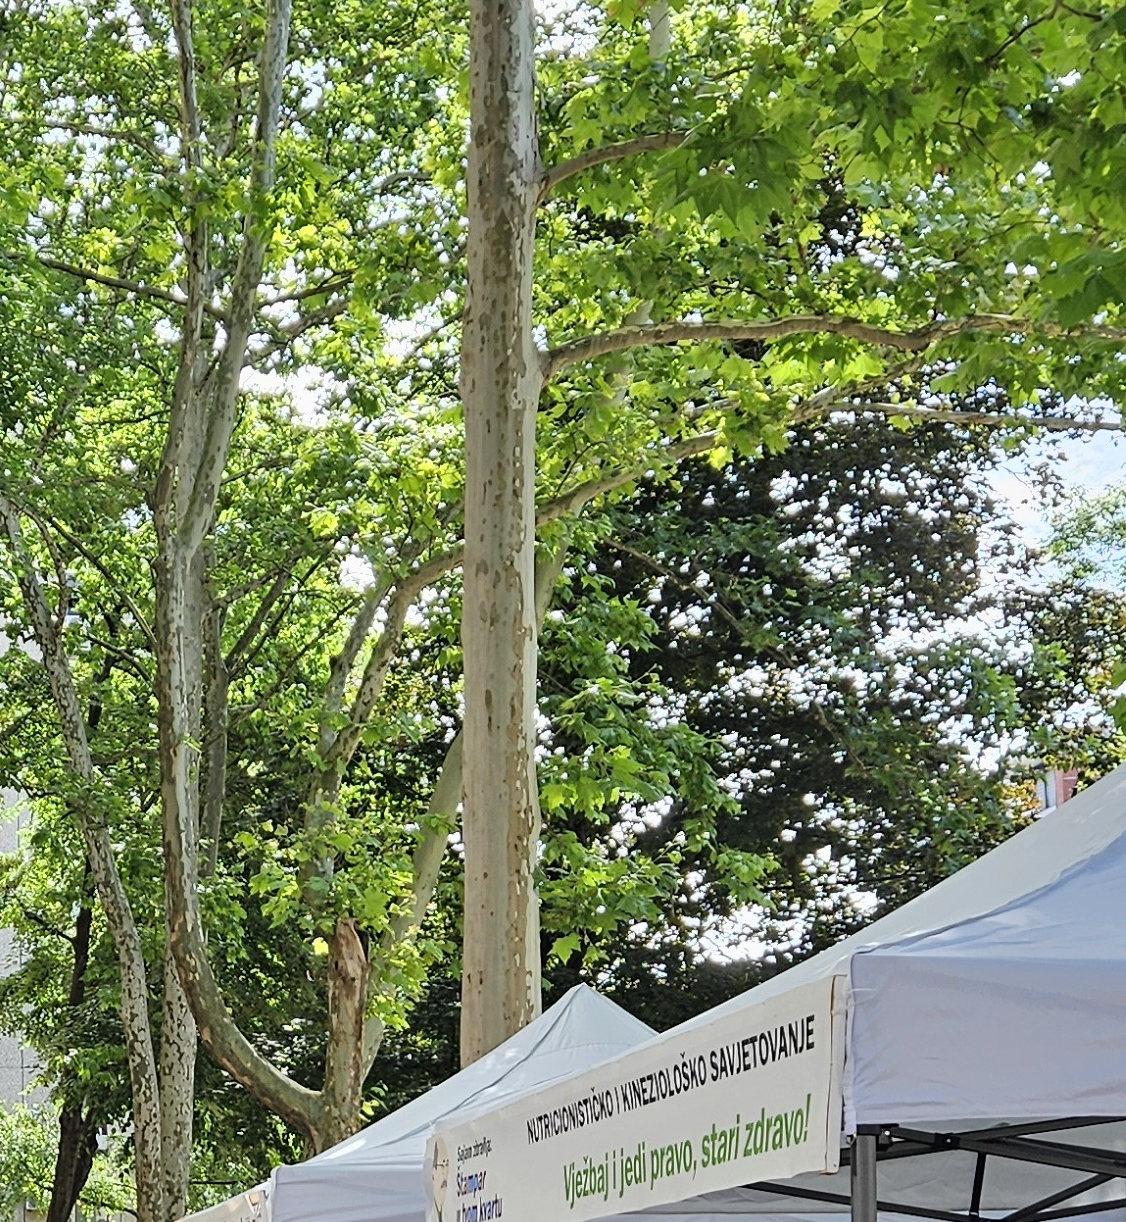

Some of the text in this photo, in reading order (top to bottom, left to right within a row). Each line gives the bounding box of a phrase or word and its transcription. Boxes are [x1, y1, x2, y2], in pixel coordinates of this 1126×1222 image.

[526, 1015, 815, 1145] NUTRICIONISTIČKO I KINEZIOLOŠKO SAVJETOVANJE
[456, 1166, 487, 1199] Štampar
[564, 1093, 812, 1210] Vježbaj i jedi pravo, stari zdravo!
[479, 1193, 503, 1222] kvartu
